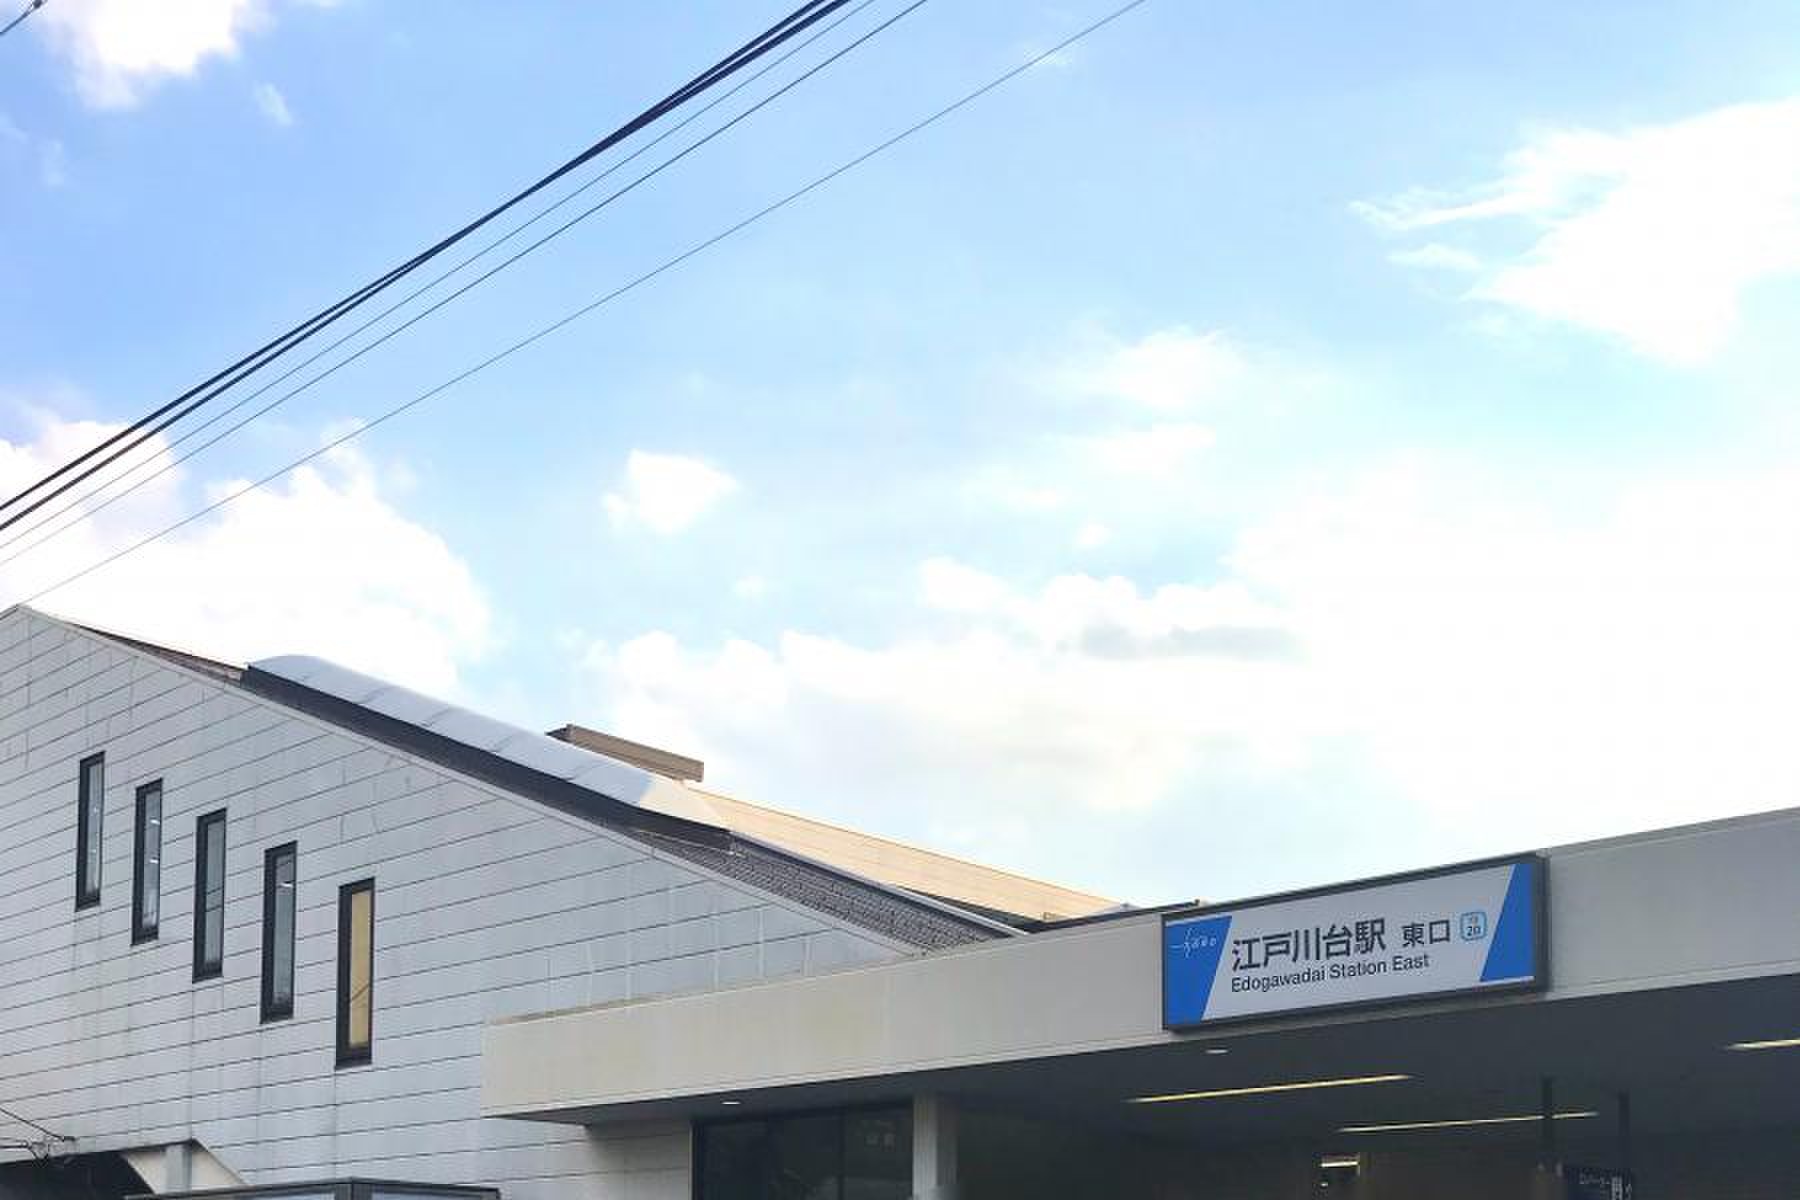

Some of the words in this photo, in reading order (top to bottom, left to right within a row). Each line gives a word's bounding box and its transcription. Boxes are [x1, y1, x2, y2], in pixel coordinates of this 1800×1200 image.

[1232, 918, 1386, 972] 江戸川台駅
[1402, 920, 1450, 947] 東口
[1231, 964, 1325, 993] Edogawadai
[1330, 957, 1386, 979] Station
[1393, 953, 1429, 971] East
